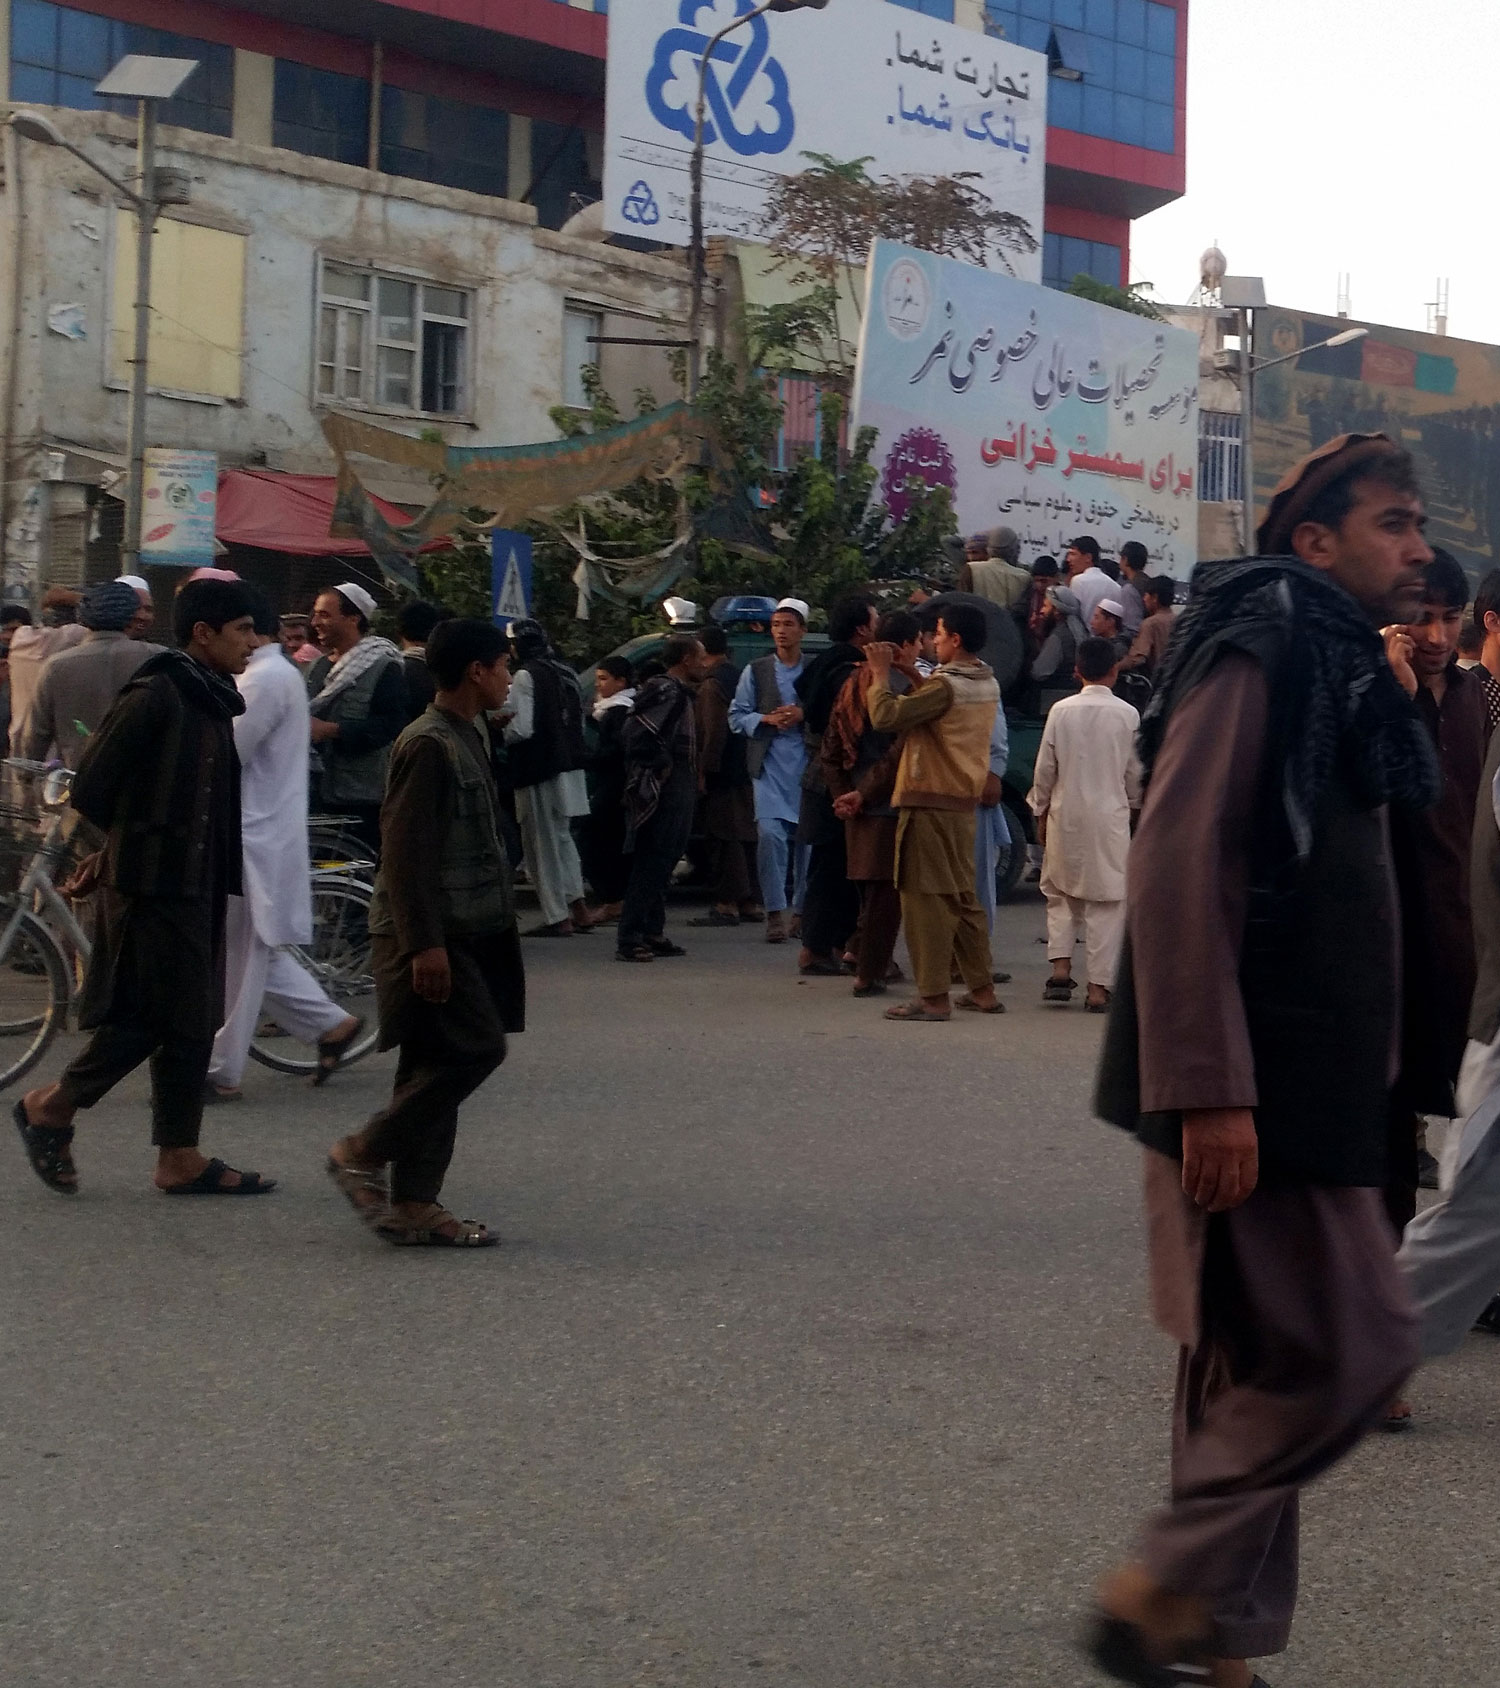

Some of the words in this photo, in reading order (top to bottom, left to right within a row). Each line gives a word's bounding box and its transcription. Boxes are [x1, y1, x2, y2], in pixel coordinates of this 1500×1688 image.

[952, 57, 1029, 105] تجارت
[963, 110, 1030, 164] بانک
[981, 420, 1057, 475] خزانی
[1062, 434, 1145, 480] سمستر
[1150, 452, 1193, 498] برای
[998, 485, 1041, 514] سیاسی
[1043, 491, 1073, 520] علوم
[1084, 499, 1118, 526] حقوق
[1167, 516, 1180, 536] در
